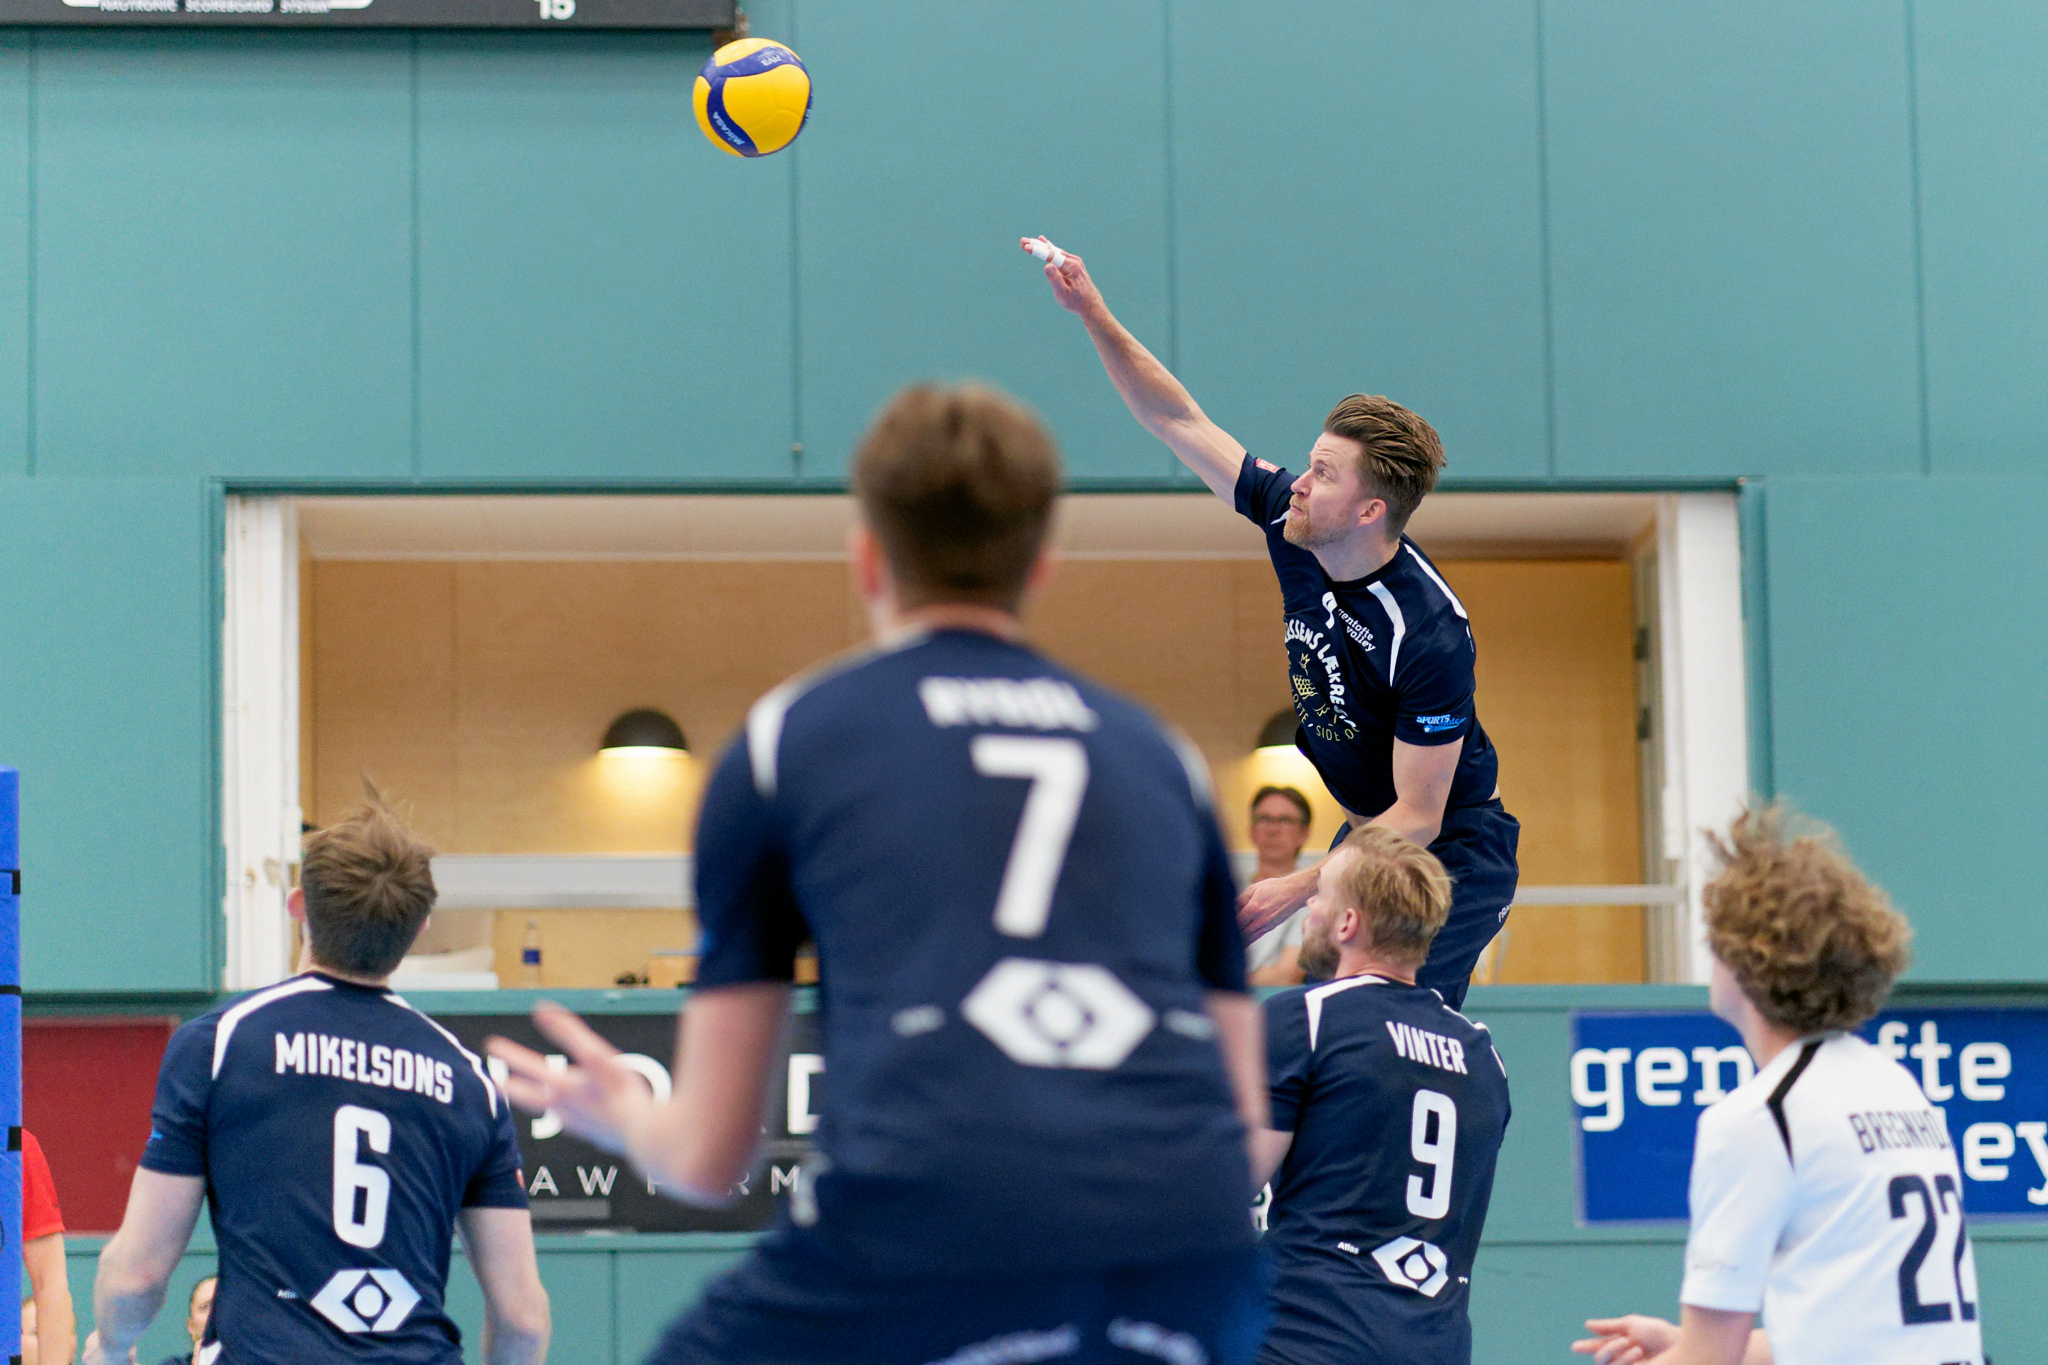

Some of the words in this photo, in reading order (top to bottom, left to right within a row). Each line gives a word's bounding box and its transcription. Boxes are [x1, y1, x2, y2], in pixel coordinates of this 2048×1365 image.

[1346, 625, 1376, 652] volley
[969, 733, 1091, 938] 7
[274, 1032, 454, 1105] MIKELSONS
[1385, 1020, 1468, 1075] VINTER
[332, 1104, 392, 1250] 6
[1406, 1088, 1457, 1220] 9
[1888, 1174, 1976, 1326] 22
